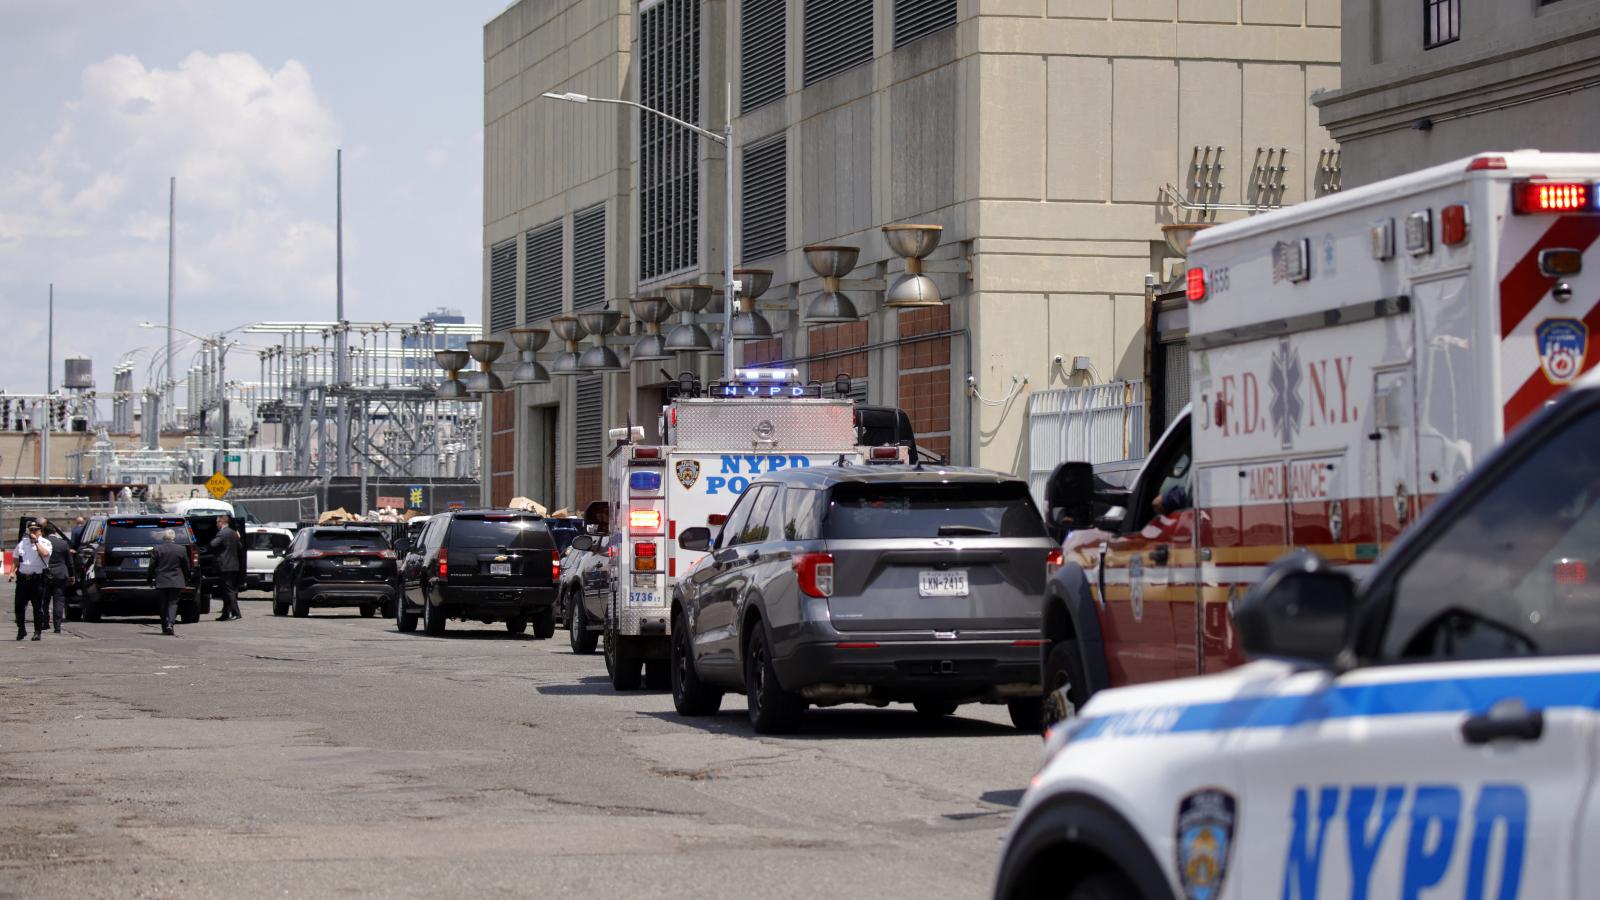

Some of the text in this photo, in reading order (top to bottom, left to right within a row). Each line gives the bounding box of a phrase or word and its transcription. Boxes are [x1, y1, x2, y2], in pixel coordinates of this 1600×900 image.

[725, 386, 804, 395] NYPD
[1309, 356, 1358, 427] N.Y.
[720, 455, 810, 474] NYPD
[630, 592, 653, 603] 5736
[1281, 784, 1534, 900] NYPD
